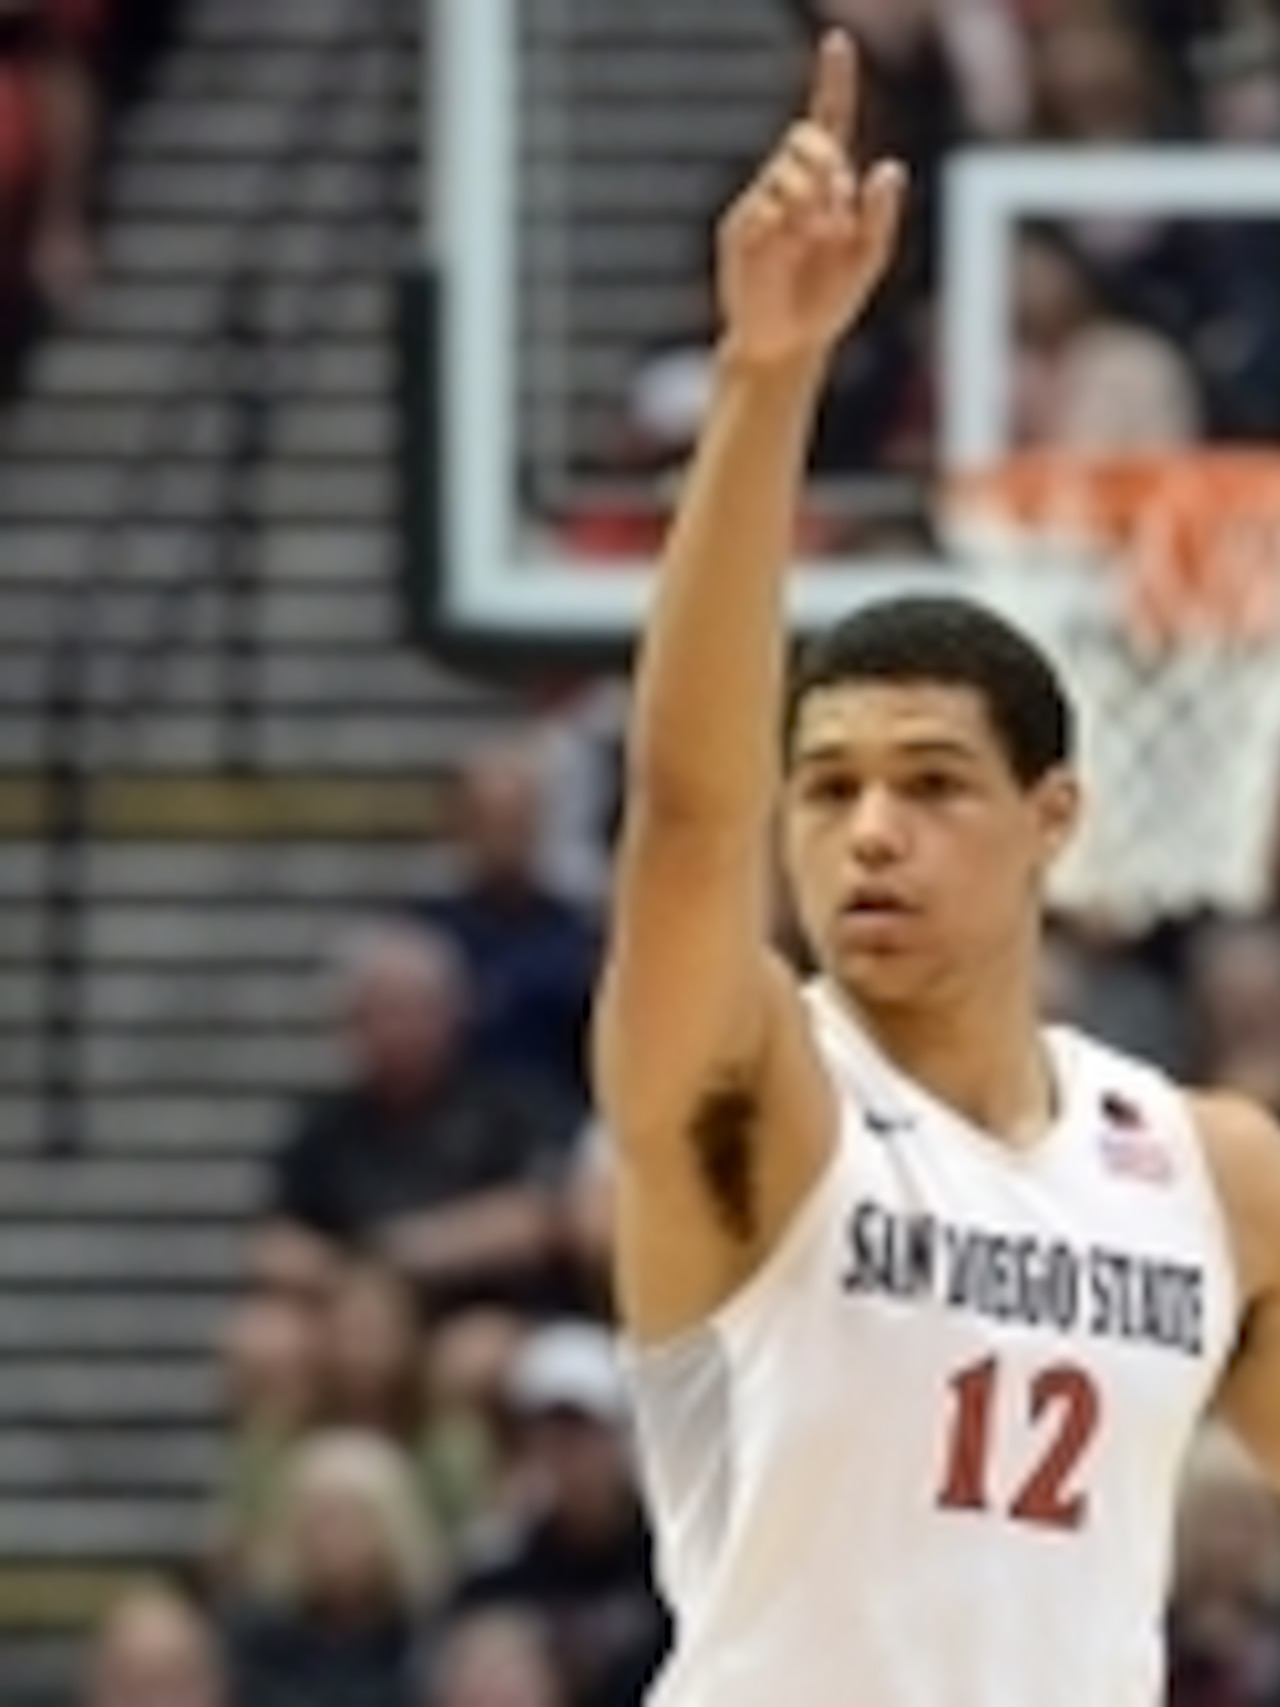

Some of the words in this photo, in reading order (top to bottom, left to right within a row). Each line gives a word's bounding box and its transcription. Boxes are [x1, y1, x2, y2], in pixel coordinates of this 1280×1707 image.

[842, 1200, 937, 1297] SAN
[945, 1222, 1080, 1334] DIEGO
[1089, 1243, 1205, 1358] STATE
[936, 1352, 1100, 1531] 12
